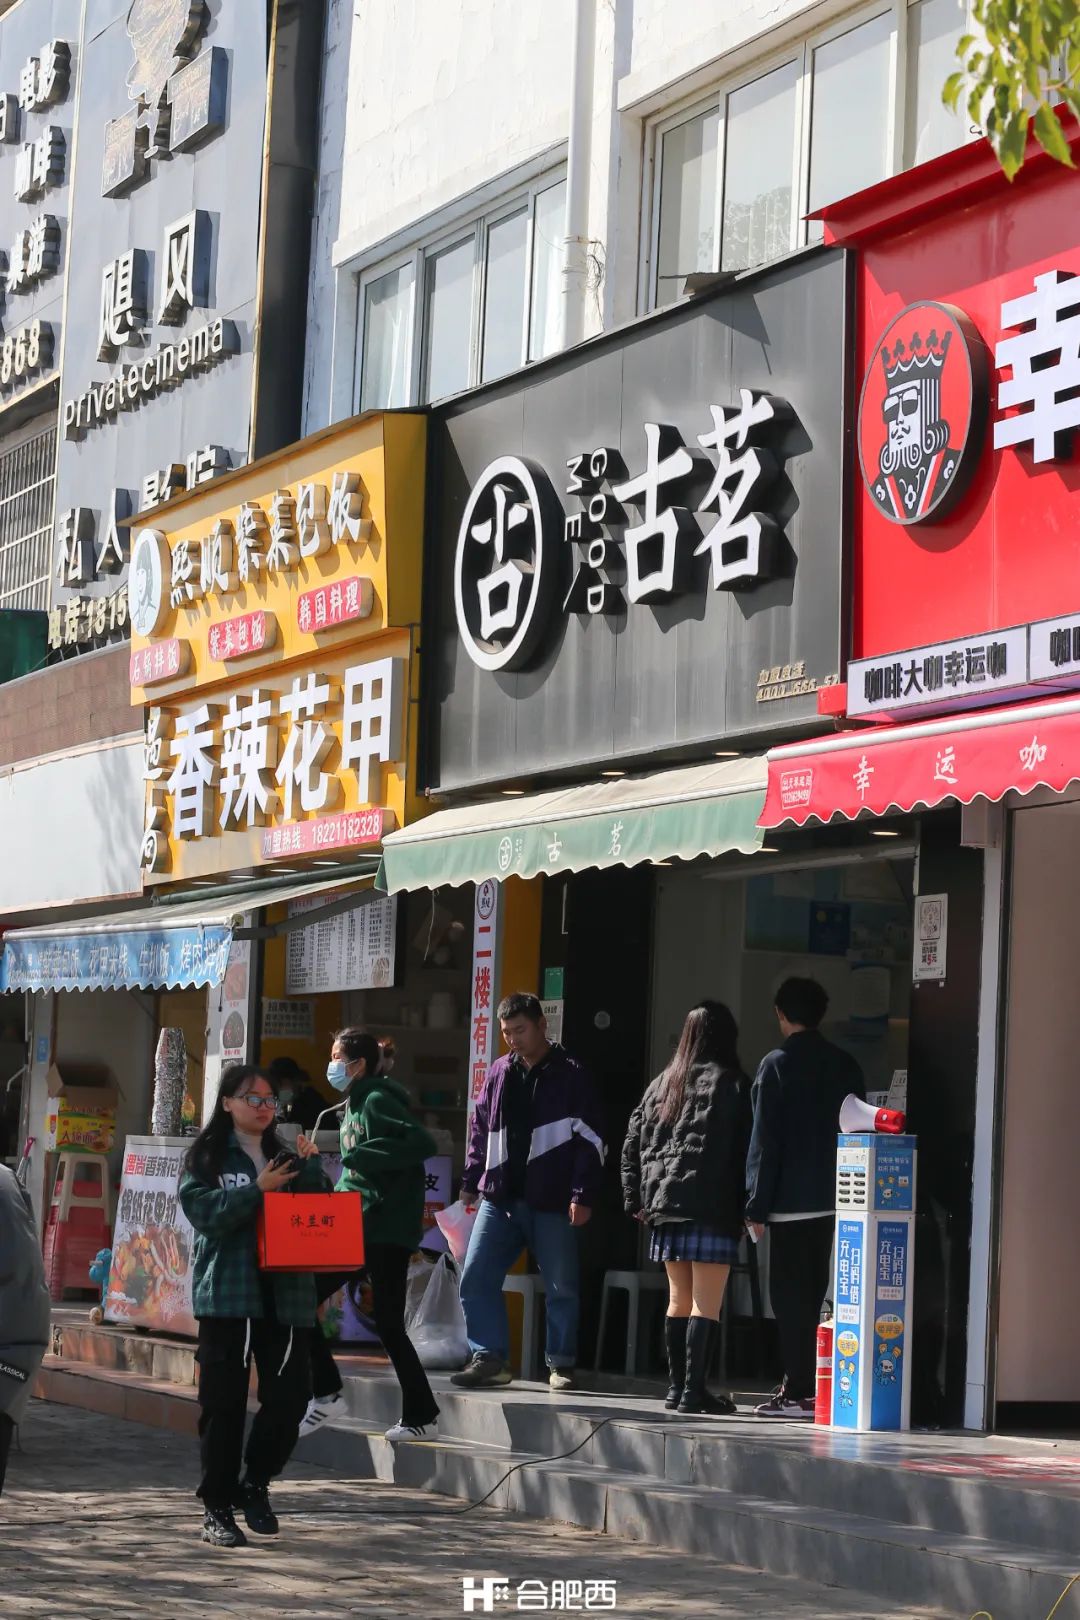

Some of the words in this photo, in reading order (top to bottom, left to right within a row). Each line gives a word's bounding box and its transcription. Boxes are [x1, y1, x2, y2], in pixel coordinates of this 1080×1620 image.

[614, 388, 775, 605] 古茗
[300, 578, 359, 631] 韩国料理
[864, 641, 1007, 704] 咖啡大咖幸运咖
[167, 657, 394, 841] 香辣花甲
[839, 1240, 849, 1296] 充电宝
[850, 1248, 860, 1304] 扫码借
[879, 1241, 892, 1281] 充电宝
